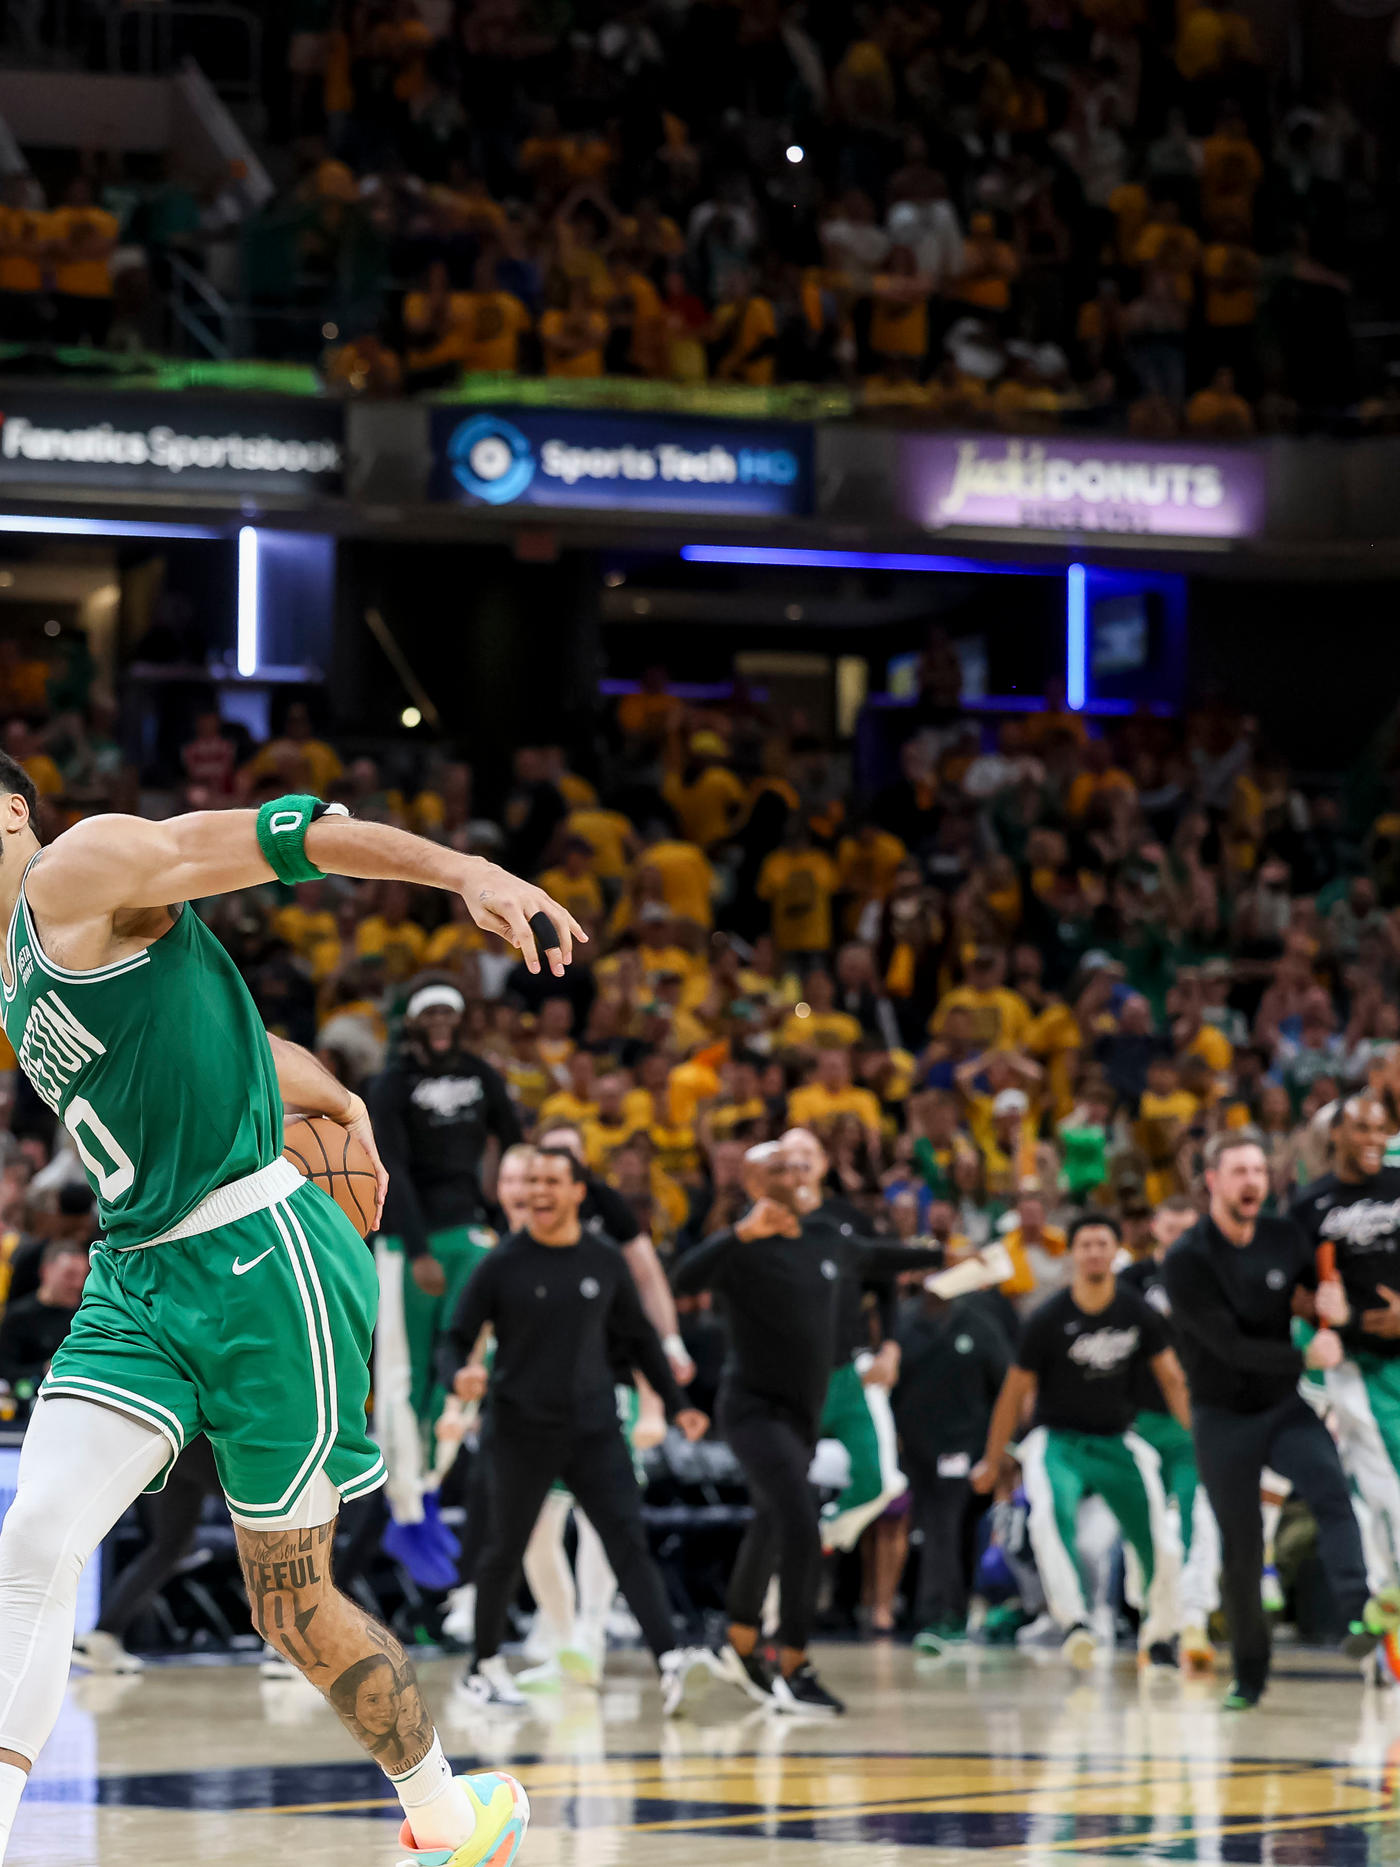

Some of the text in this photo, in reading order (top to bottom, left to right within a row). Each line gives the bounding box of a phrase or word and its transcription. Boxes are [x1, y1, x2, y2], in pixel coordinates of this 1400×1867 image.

[2, 416, 150, 465] Fanatics
[1044, 458, 1225, 508] DONUTS
[63, 1094, 136, 1203] 0
